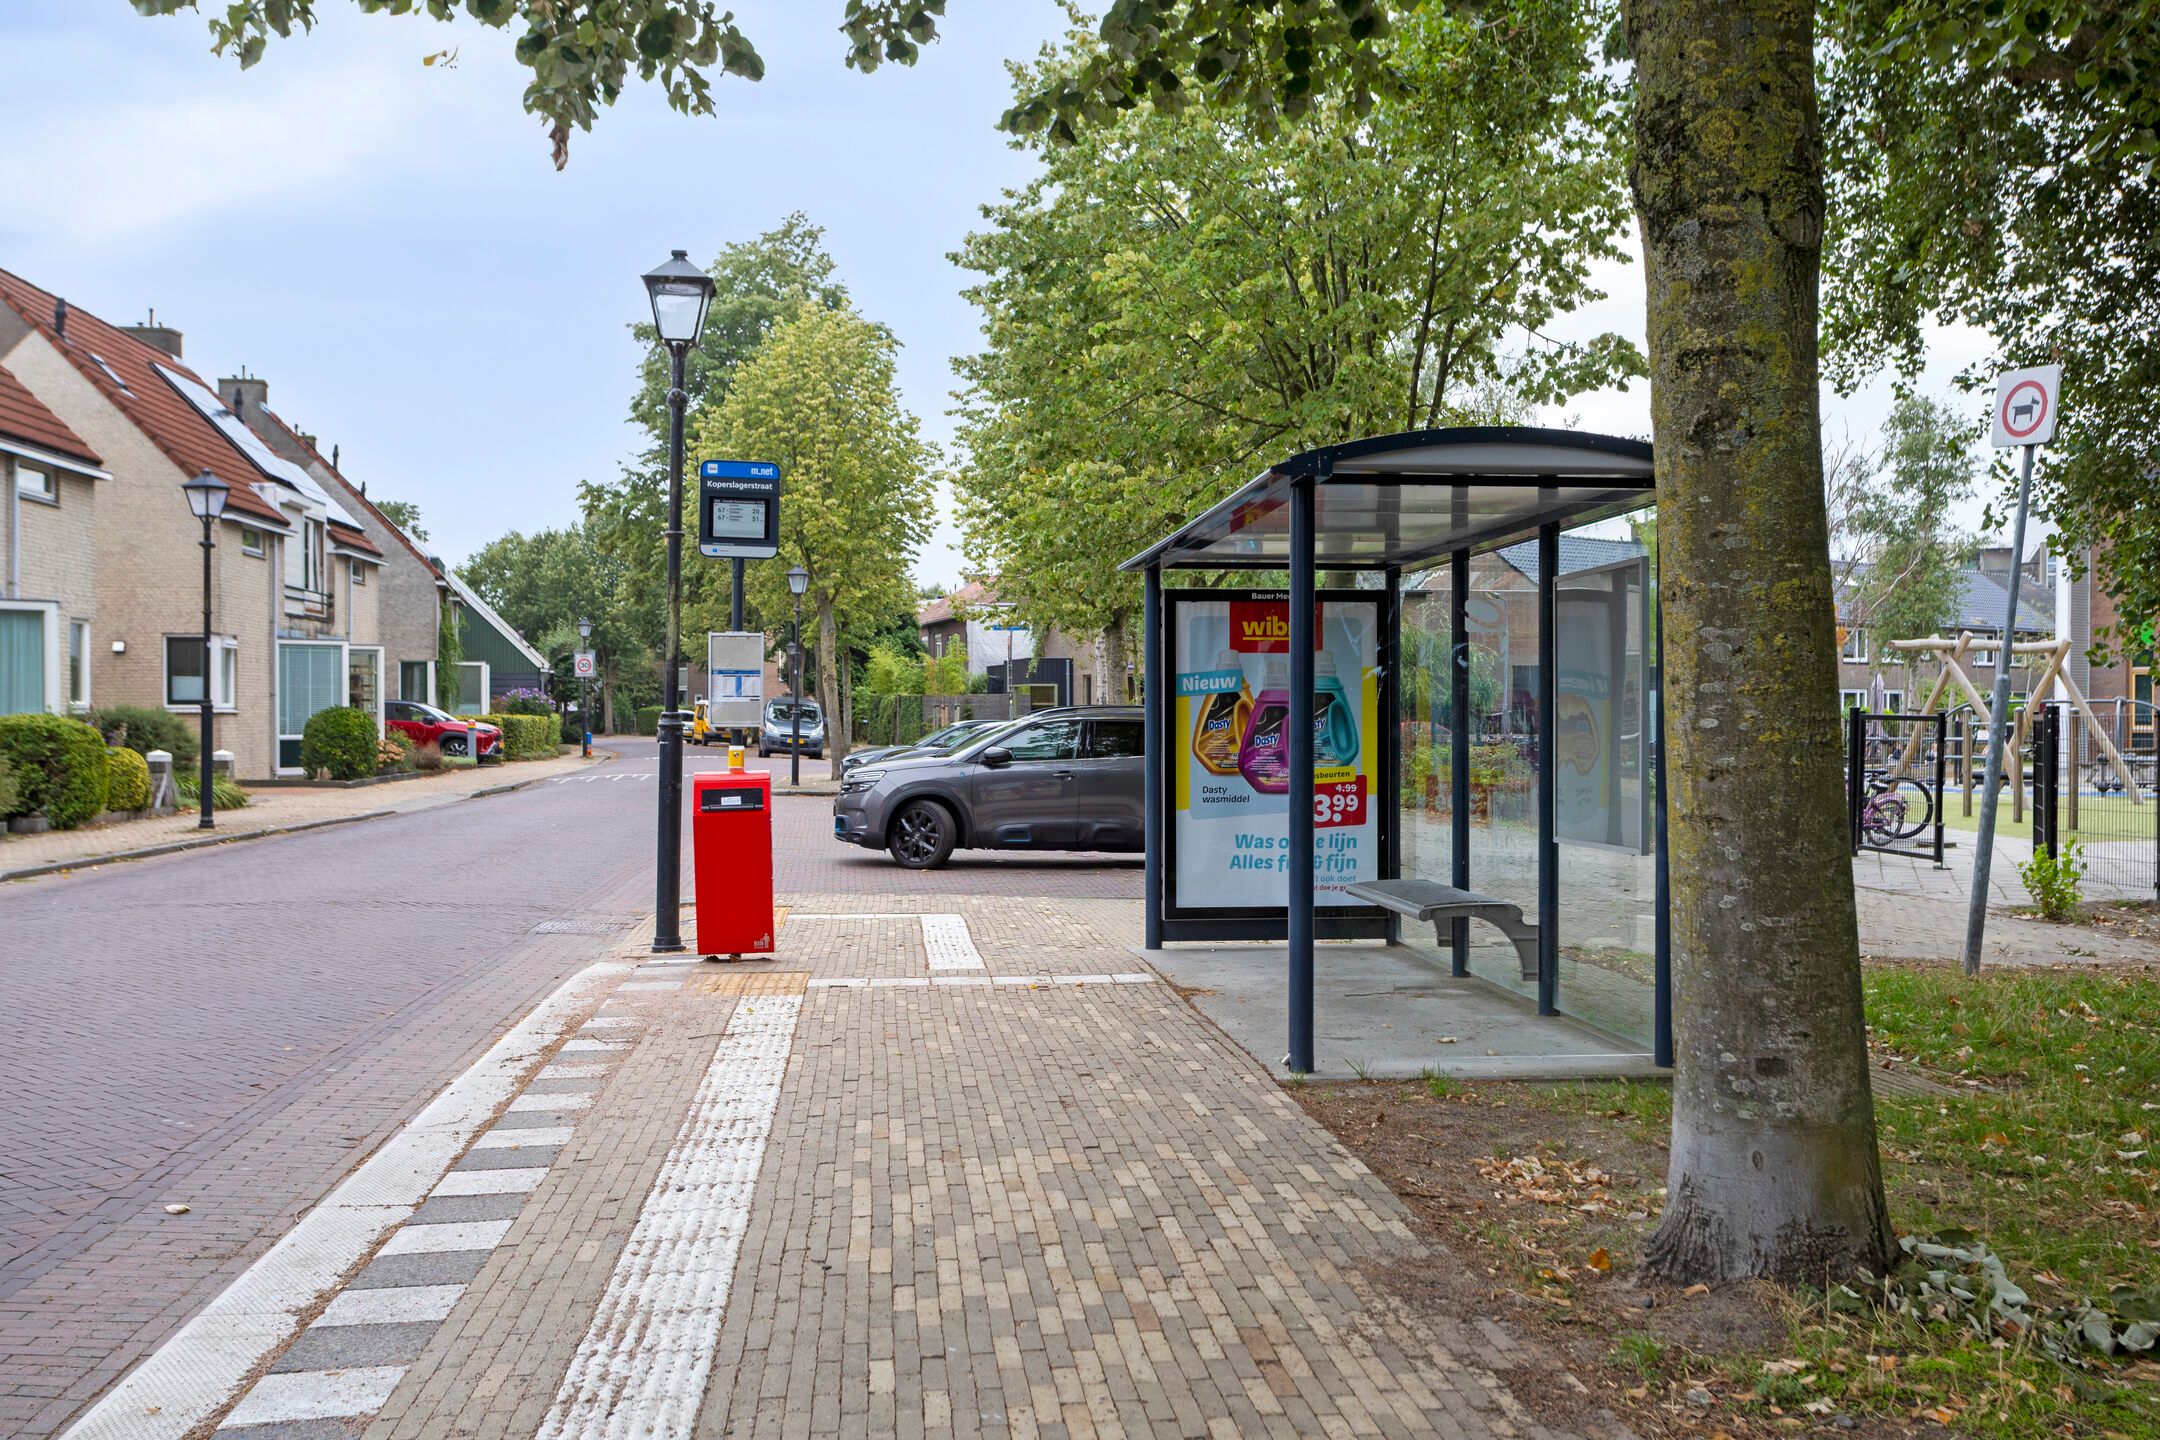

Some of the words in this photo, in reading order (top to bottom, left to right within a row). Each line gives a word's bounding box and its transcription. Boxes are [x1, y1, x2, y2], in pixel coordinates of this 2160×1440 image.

[751, 467, 773, 476] m.net
[707, 480, 772, 490] Koperslagerstraat
[1251, 592, 1275, 600] Bauer
[1242, 615, 1290, 636] wib
[1182, 675, 1237, 691] Nieuw
[1208, 717, 1232, 732] Dasty
[1255, 733, 1280, 748] Dasty
[1313, 771, 1350, 779] sbeurten
[1202, 786, 1228, 795] Dasty
[1335, 784, 1357, 793] 4.99
[1202, 795, 1250, 803] wasmiddel
[1314, 794, 1359, 823] 3.99
[1234, 834, 1274, 849] Was
[1328, 833, 1358, 853] lijn
[1229, 854, 1274, 869] Alles
[1326, 853, 1358, 873] fijn
[1320, 874, 1335, 882] ook
